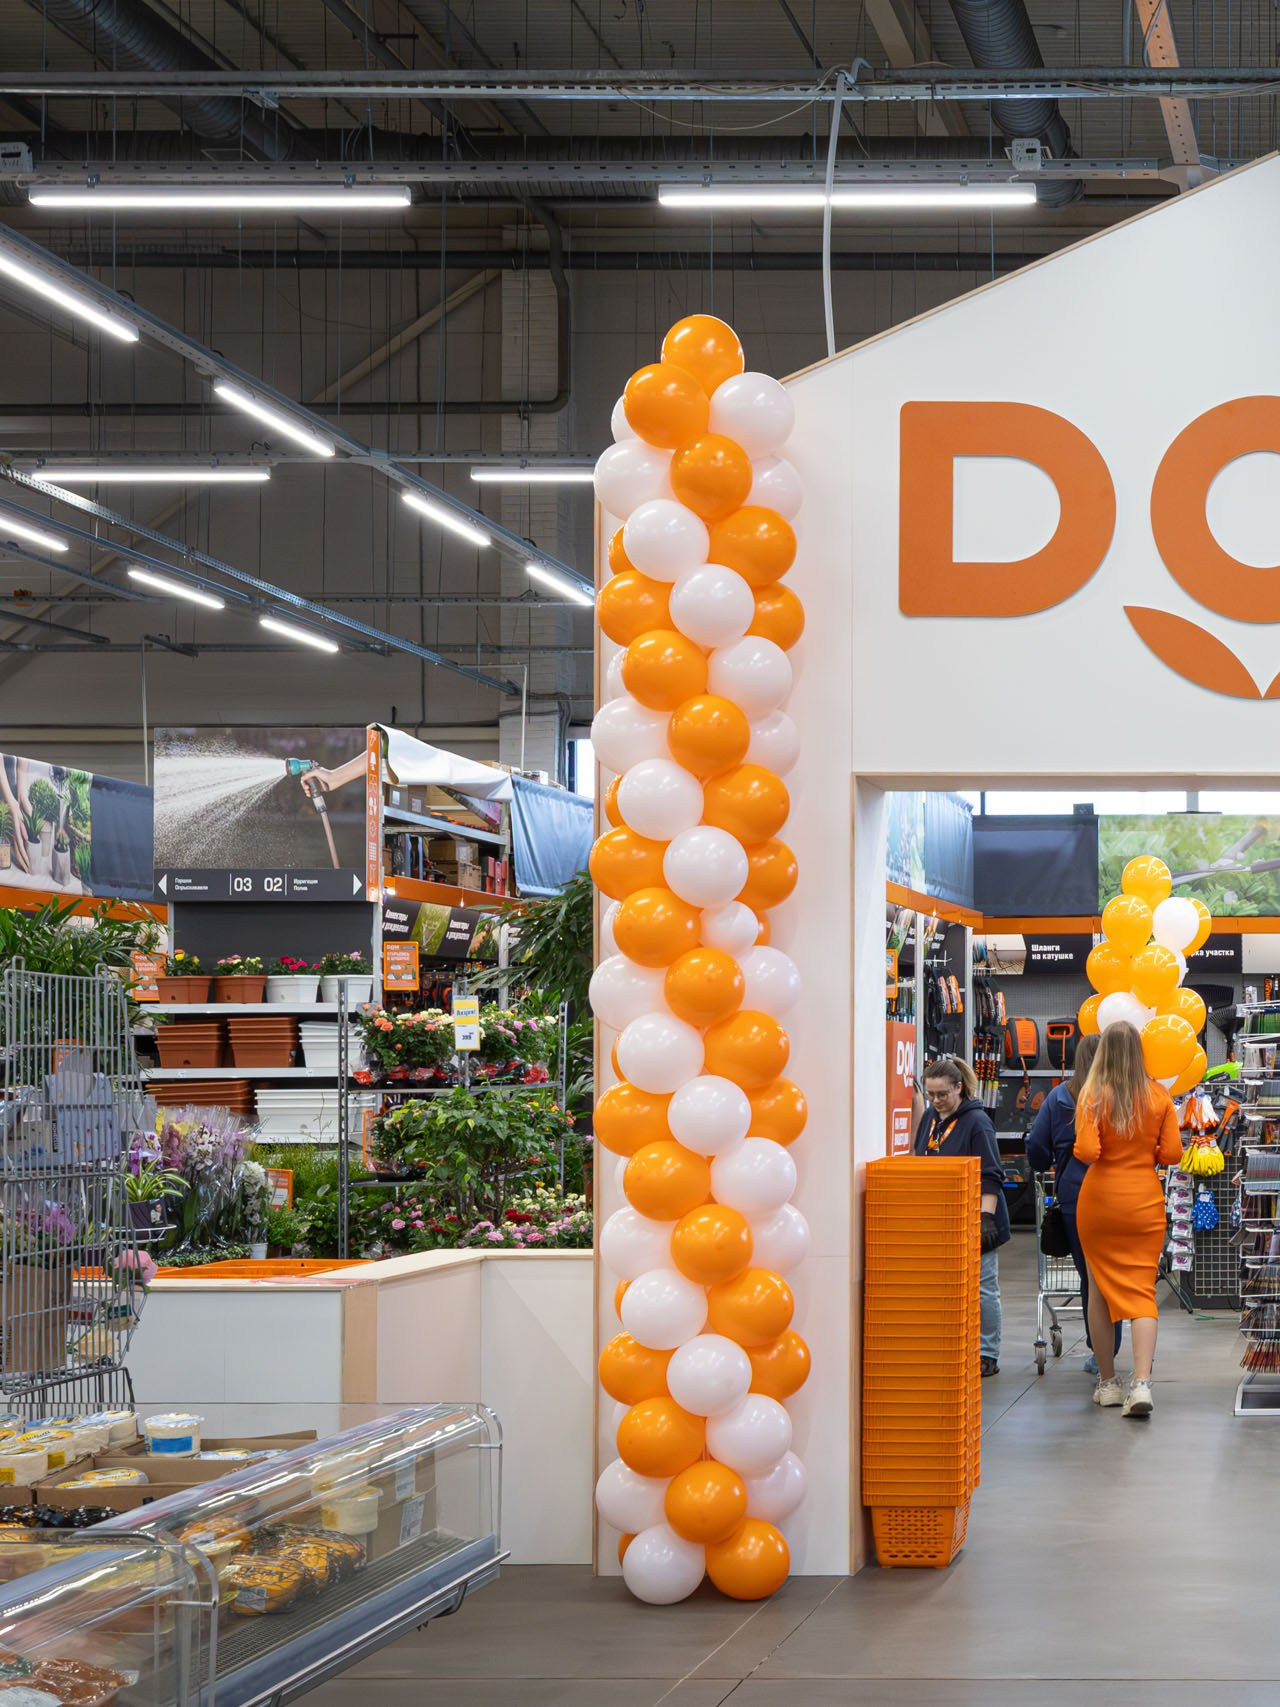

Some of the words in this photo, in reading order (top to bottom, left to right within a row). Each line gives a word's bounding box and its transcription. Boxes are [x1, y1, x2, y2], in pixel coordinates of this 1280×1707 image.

[233, 877, 253, 892] 03
[264, 877, 283, 892] 02
[1042, 952, 1074, 960] катушке
[1205, 949, 1234, 957] участка
